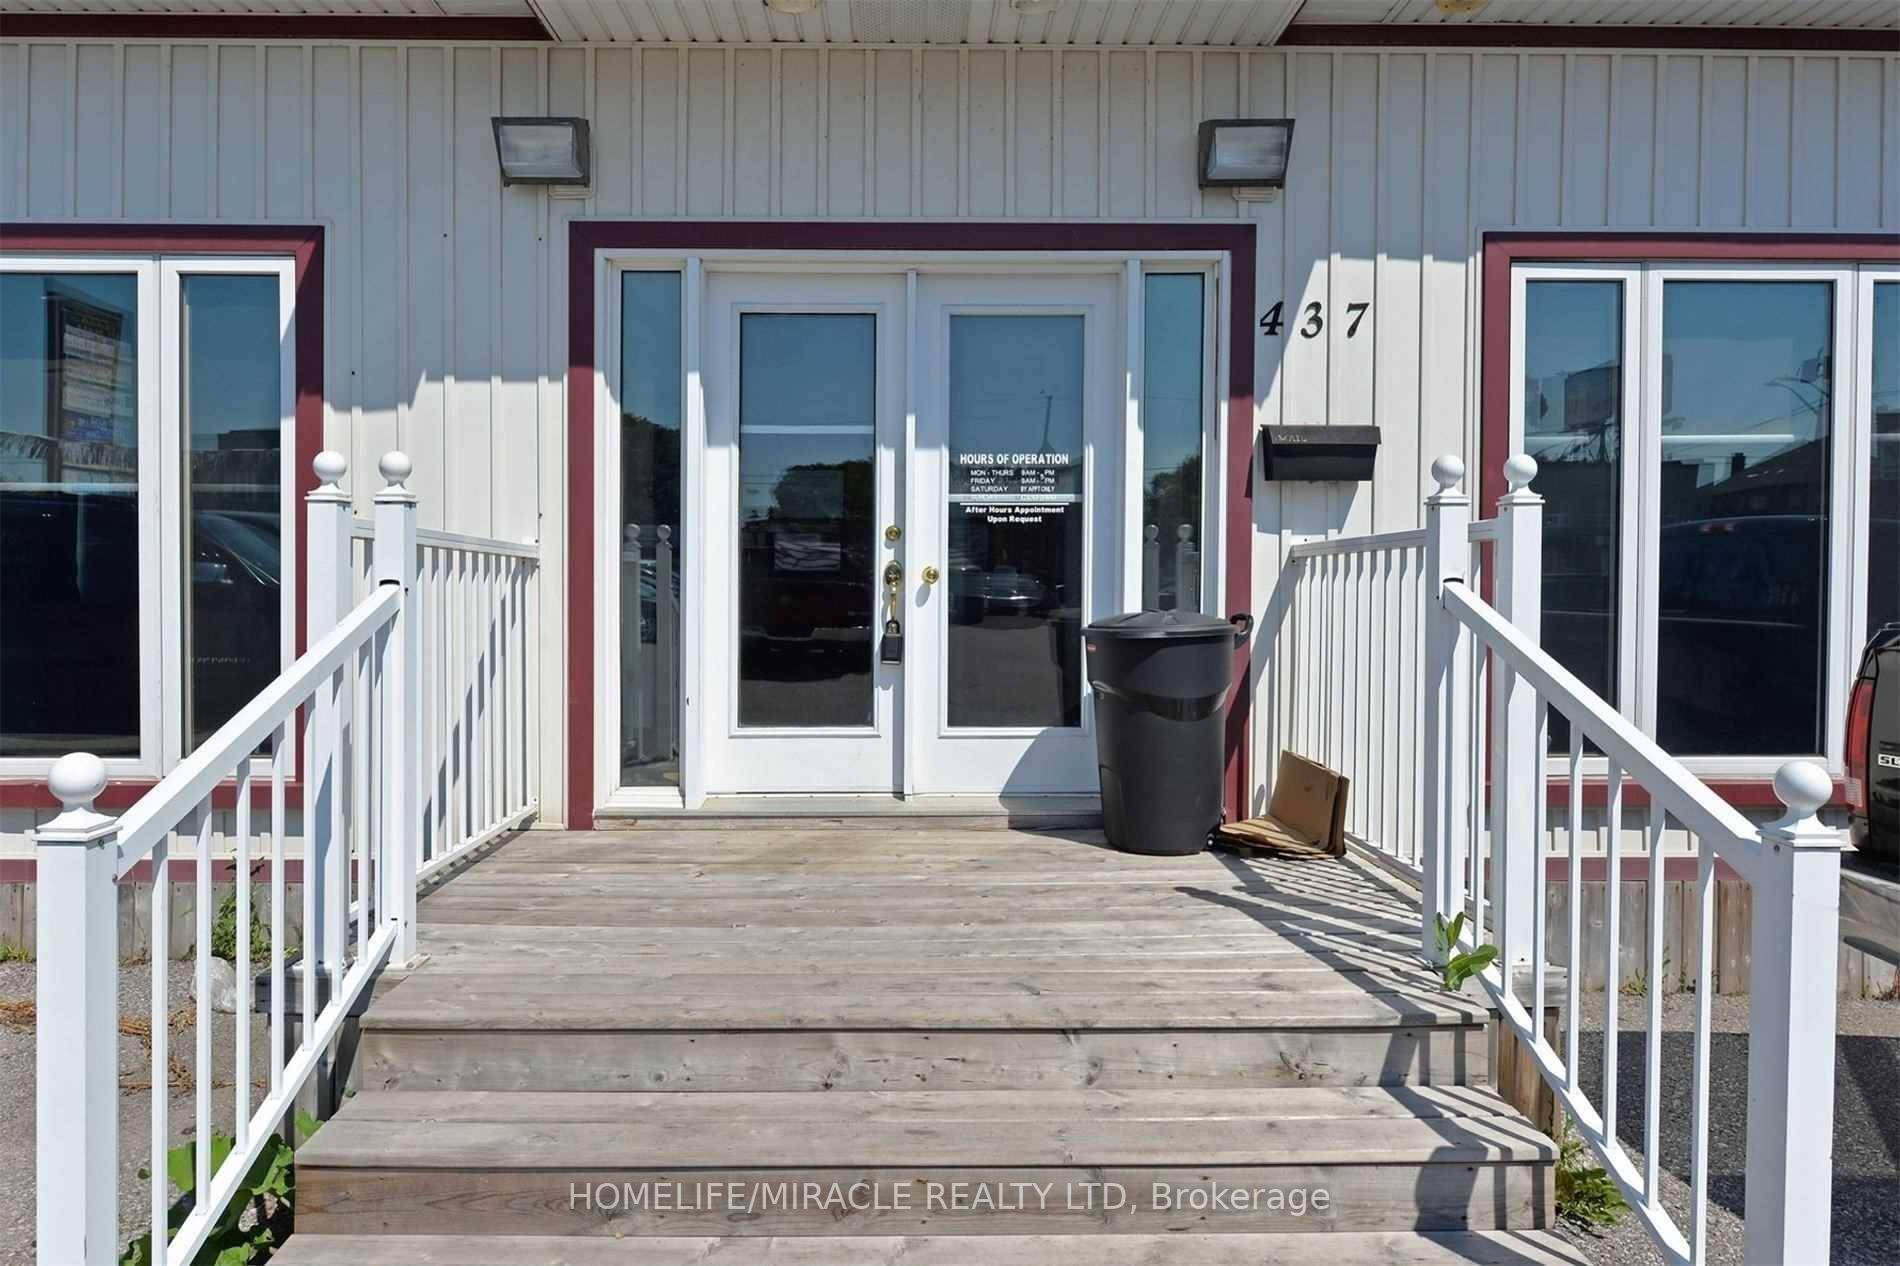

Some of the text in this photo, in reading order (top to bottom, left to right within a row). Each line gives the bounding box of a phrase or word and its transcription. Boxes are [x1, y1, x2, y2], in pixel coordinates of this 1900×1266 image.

[960, 454, 1068, 464] HOURS OF OPERATION
[970, 477, 995, 485] FRIDAY
[970, 485, 1008, 493] SATURDAY
[965, 506, 1065, 515] After Hours Appointment
[987, 515, 1042, 524] Upon Request
